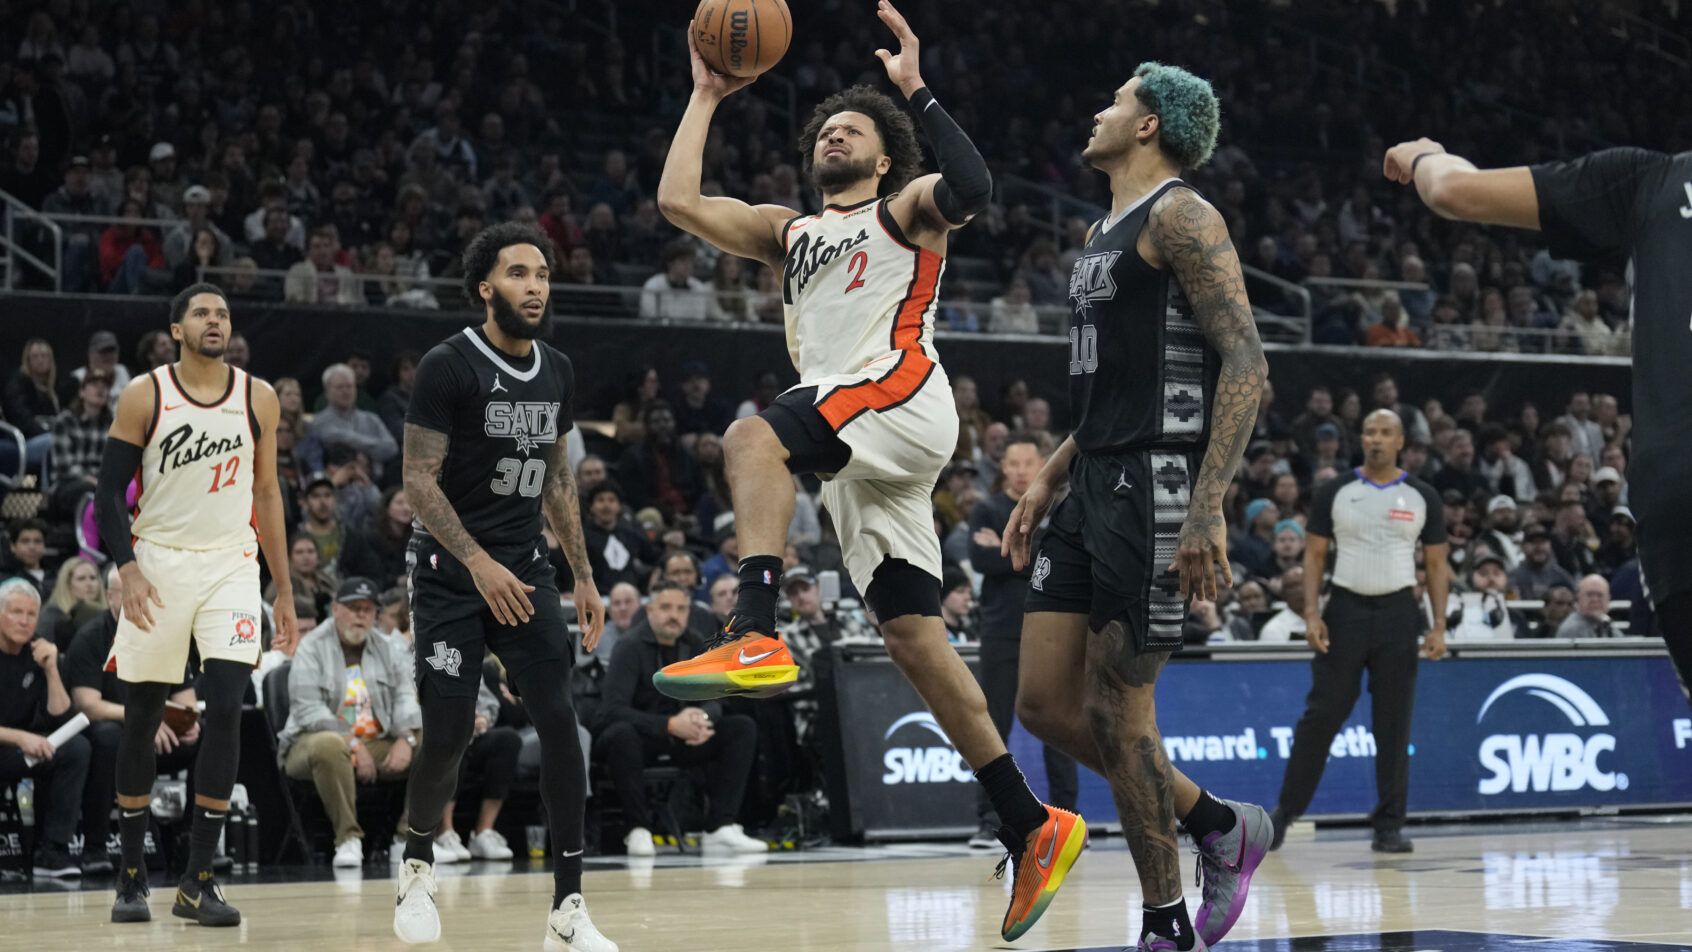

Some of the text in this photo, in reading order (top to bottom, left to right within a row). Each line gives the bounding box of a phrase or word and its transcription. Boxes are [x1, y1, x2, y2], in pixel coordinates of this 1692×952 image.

[730, 10, 748, 70] Wilson
[845, 251, 868, 295] 2
[1069, 324, 1099, 375] 10
[484, 401, 561, 444] SATX
[158, 422, 244, 475] Pistons
[207, 455, 240, 494] 12
[490, 457, 547, 498] 30
